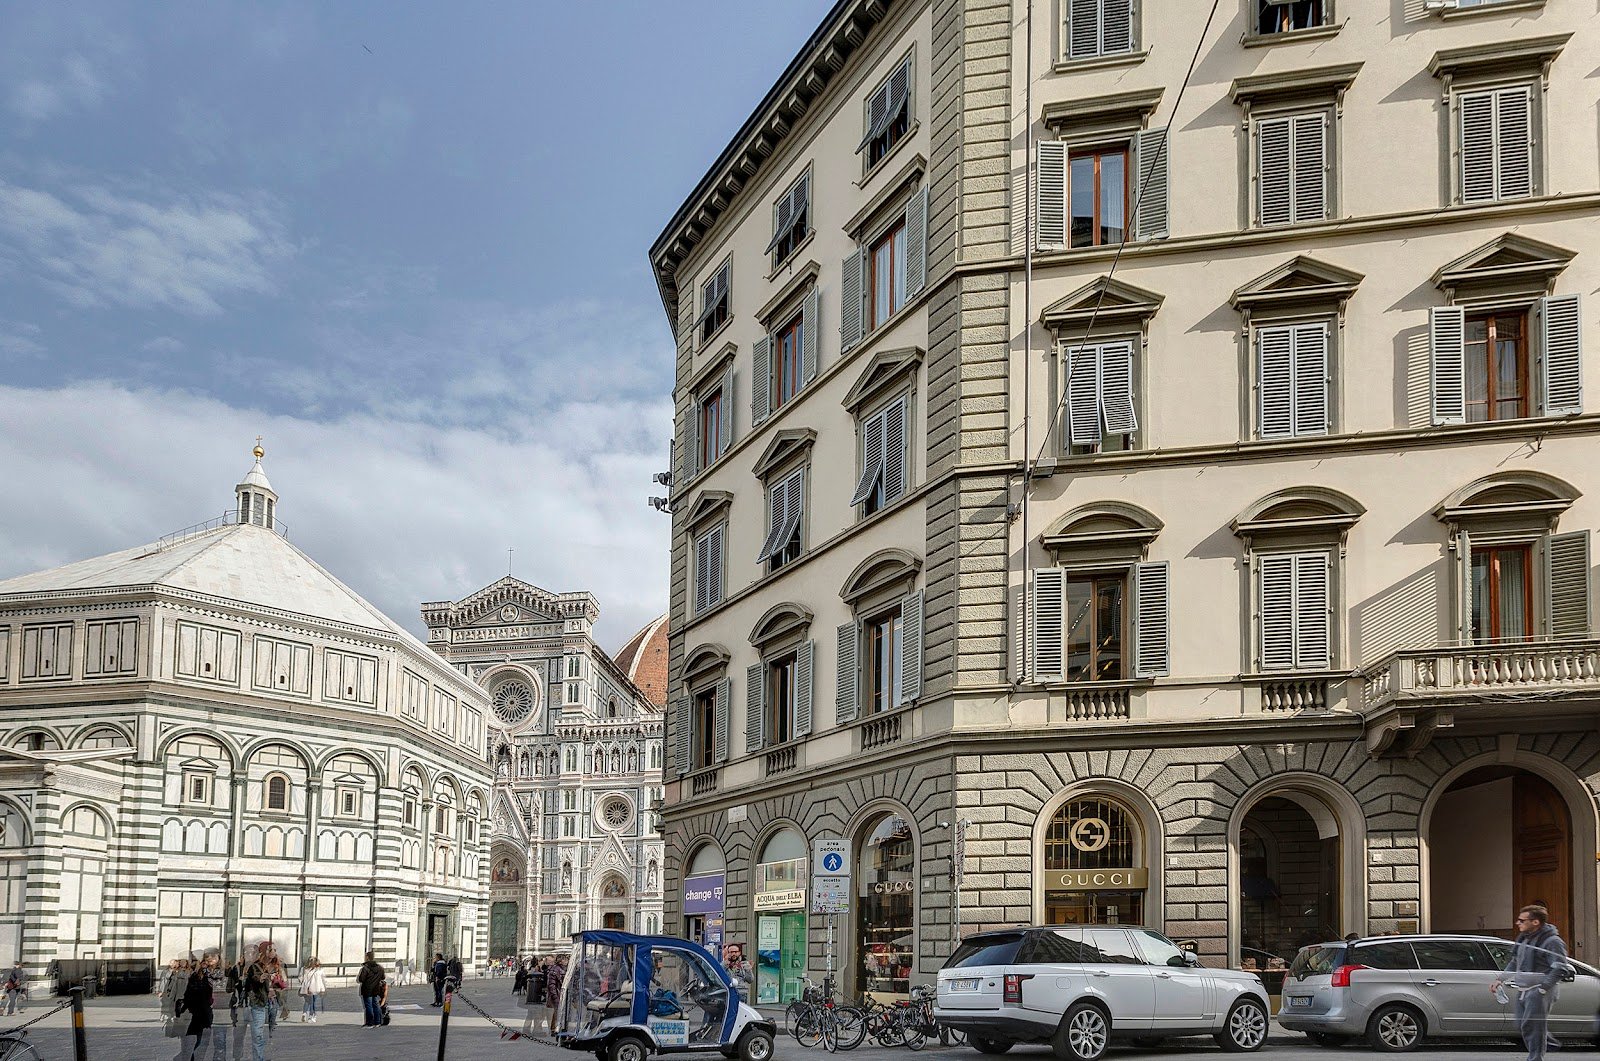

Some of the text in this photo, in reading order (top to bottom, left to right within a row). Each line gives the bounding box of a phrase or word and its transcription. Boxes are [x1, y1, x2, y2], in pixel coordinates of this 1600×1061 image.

[1060, 873, 1132, 886] GUCCI
[685, 889, 712, 902] change
[756, 895, 775, 903] ACQUA
